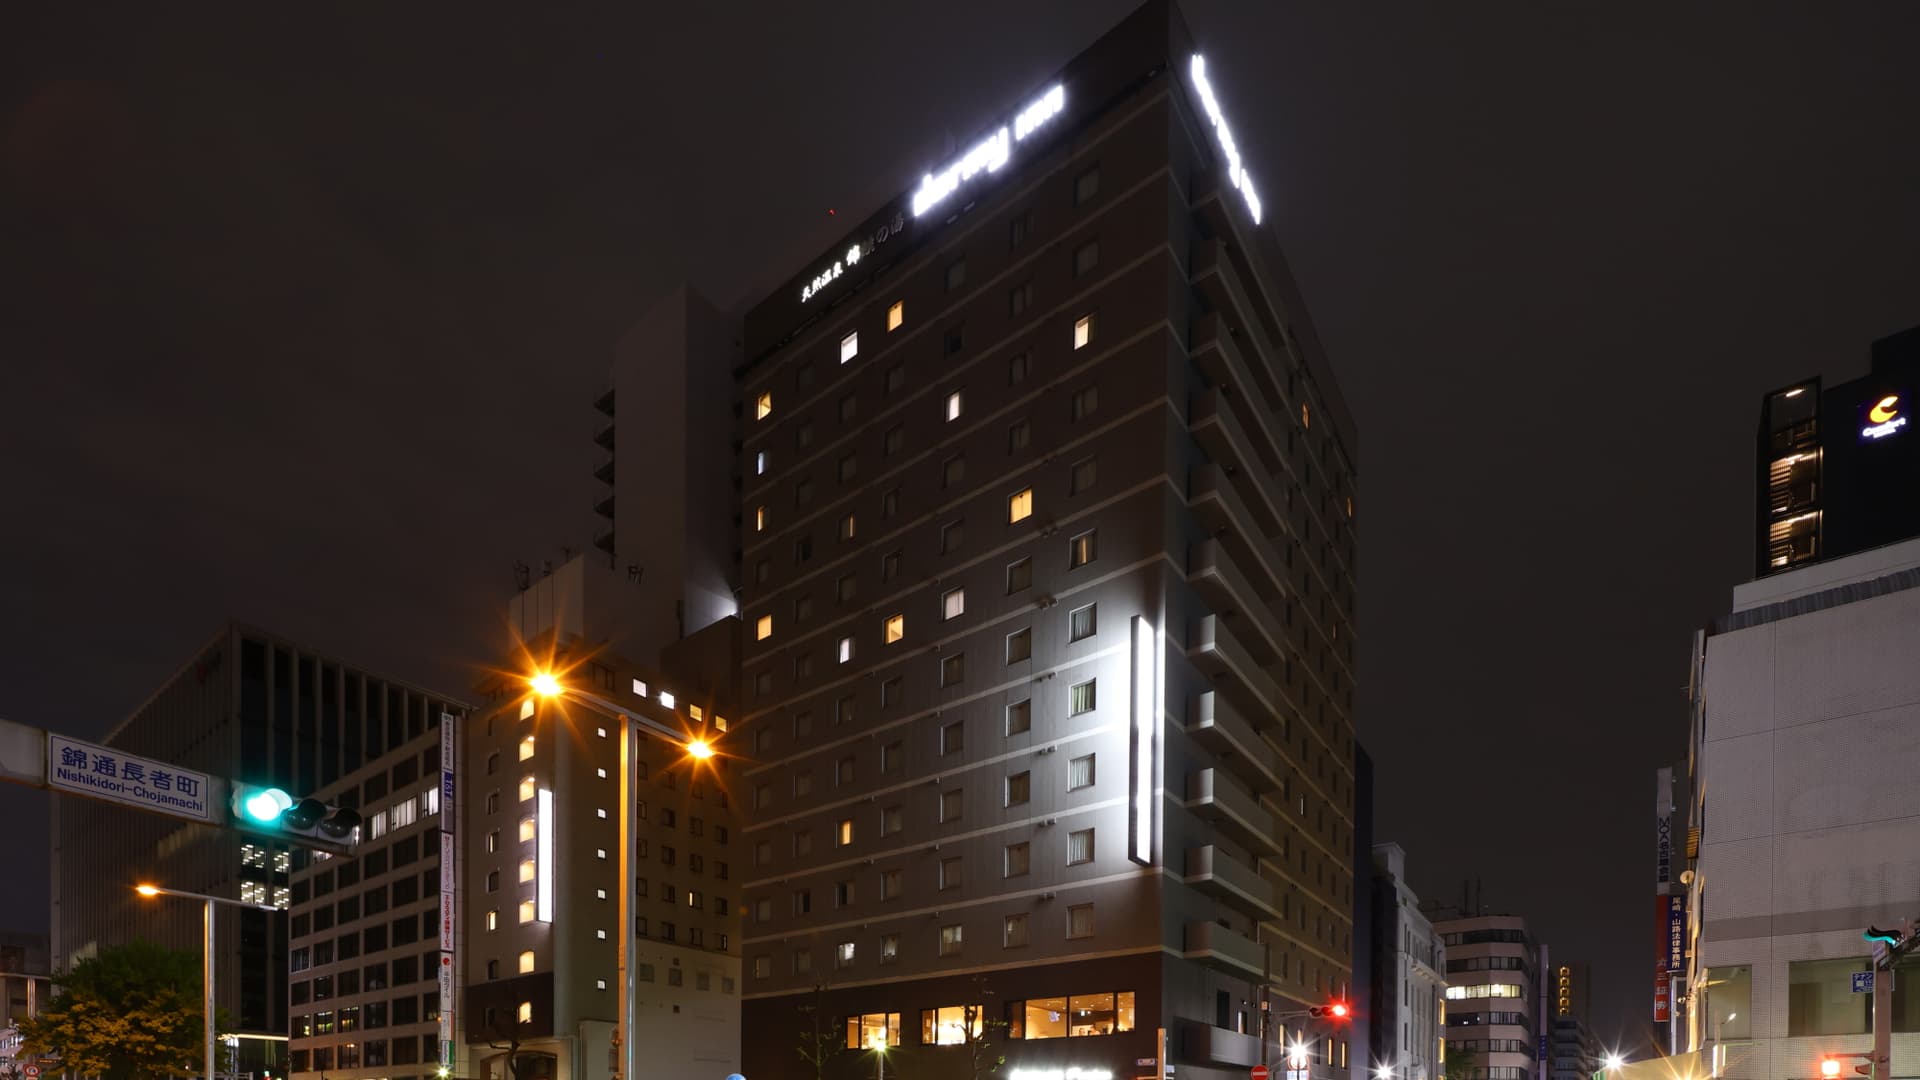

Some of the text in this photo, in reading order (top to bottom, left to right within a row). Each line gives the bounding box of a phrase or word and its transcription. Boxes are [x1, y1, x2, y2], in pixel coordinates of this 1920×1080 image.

[57, 766, 204, 812] Nishikidori-Chojamachi
[61, 746, 201, 798] 錦通長者町
